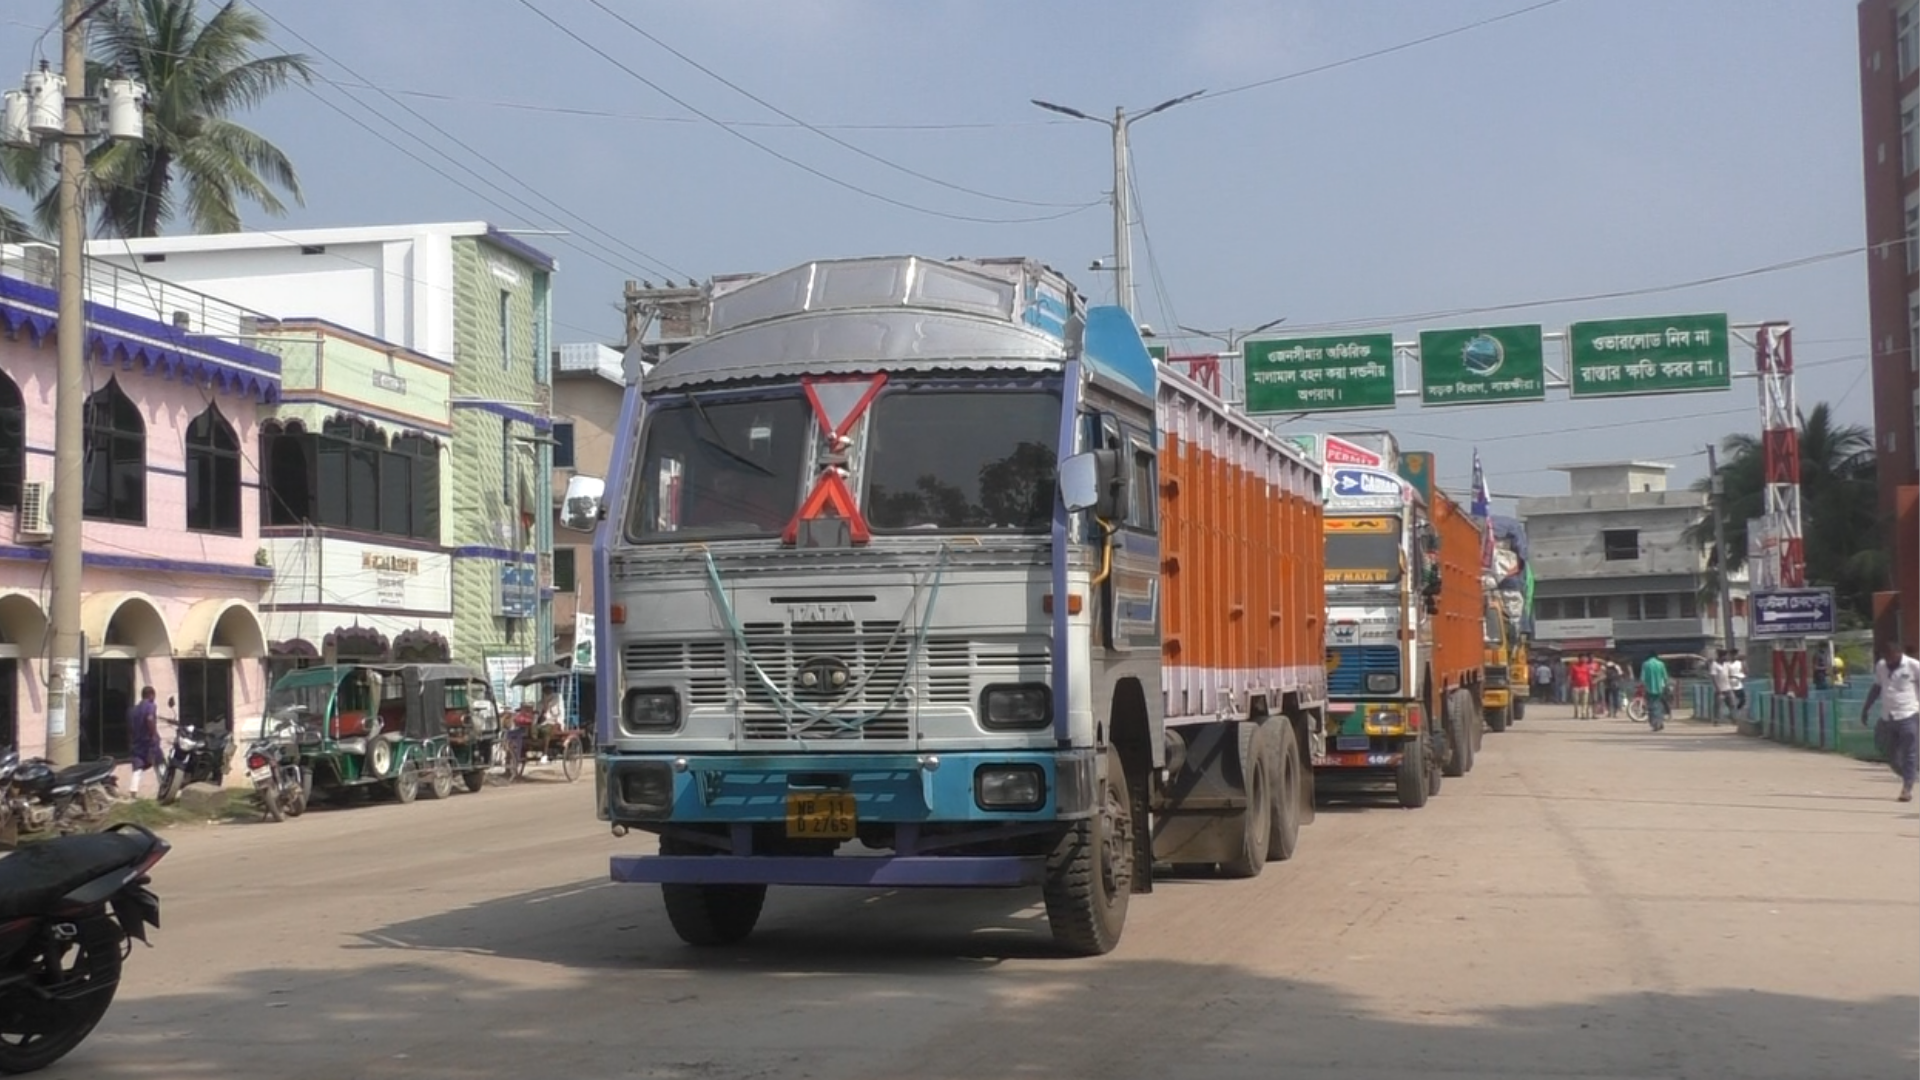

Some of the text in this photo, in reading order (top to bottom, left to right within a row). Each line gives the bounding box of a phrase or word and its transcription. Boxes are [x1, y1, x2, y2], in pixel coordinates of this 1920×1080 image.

[1592, 327, 1710, 350] ওভারলোড নিব না
[1299, 368, 1323, 381] বহন
[1580, 365, 1621, 382] রাস্তার
[1623, 359, 1657, 379] ক্ষতি
[1660, 361, 1694, 378] করব
[787, 604, 854, 621] TATA
[829, 800, 844, 816] 11
[813, 818, 849, 833] 2765
